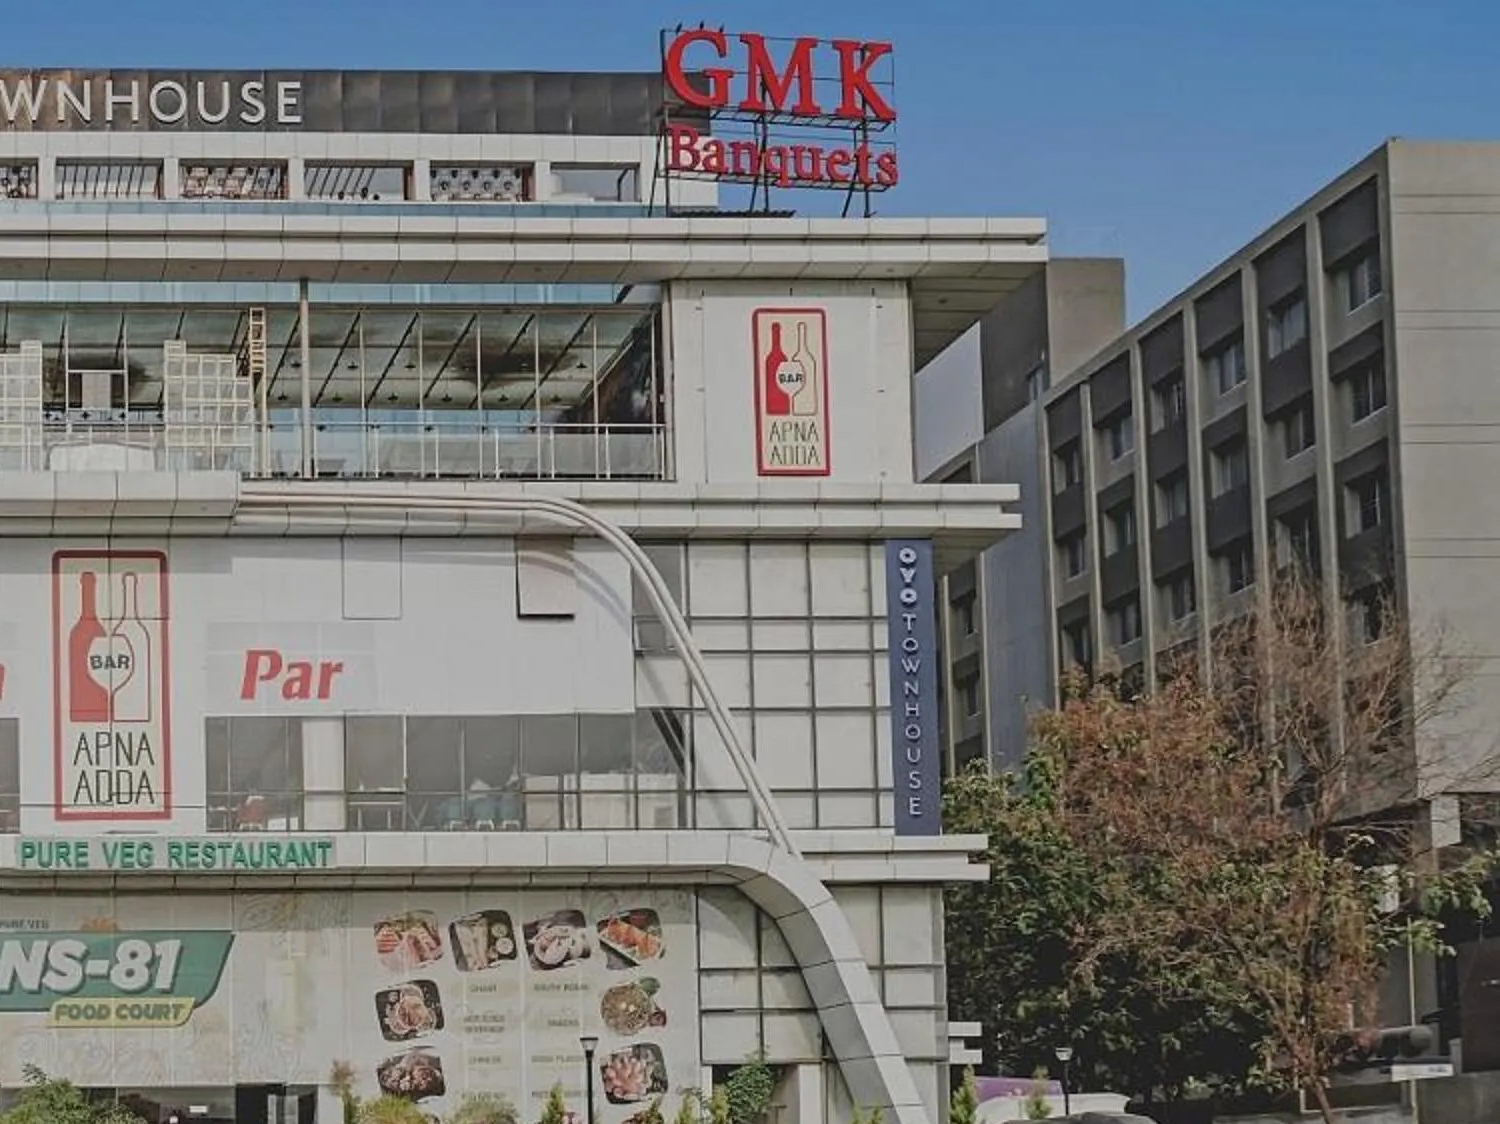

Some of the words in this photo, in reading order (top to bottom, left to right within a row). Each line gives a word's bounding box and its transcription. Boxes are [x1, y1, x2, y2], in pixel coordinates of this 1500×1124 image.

[665, 29, 896, 121] GMK
[667, 124, 898, 188] Banquets
[778, 373, 803, 384] BAR
[769, 420, 819, 442] APNA
[770, 445, 820, 465] ADDA
[899, 547, 918, 604] OYO
[90, 654, 130, 671] BAR
[241, 650, 343, 700] Par
[901, 613, 923, 816] TOWNHOUSE
[73, 731, 156, 767] APNA
[73, 769, 155, 805] ADDA
[20, 841, 89, 868] PURE
[102, 841, 154, 868] VEG
[167, 841, 333, 868] RESTAURANT
[55, 1004, 110, 1021] FOOD
[115, 1003, 185, 1020] COURT
